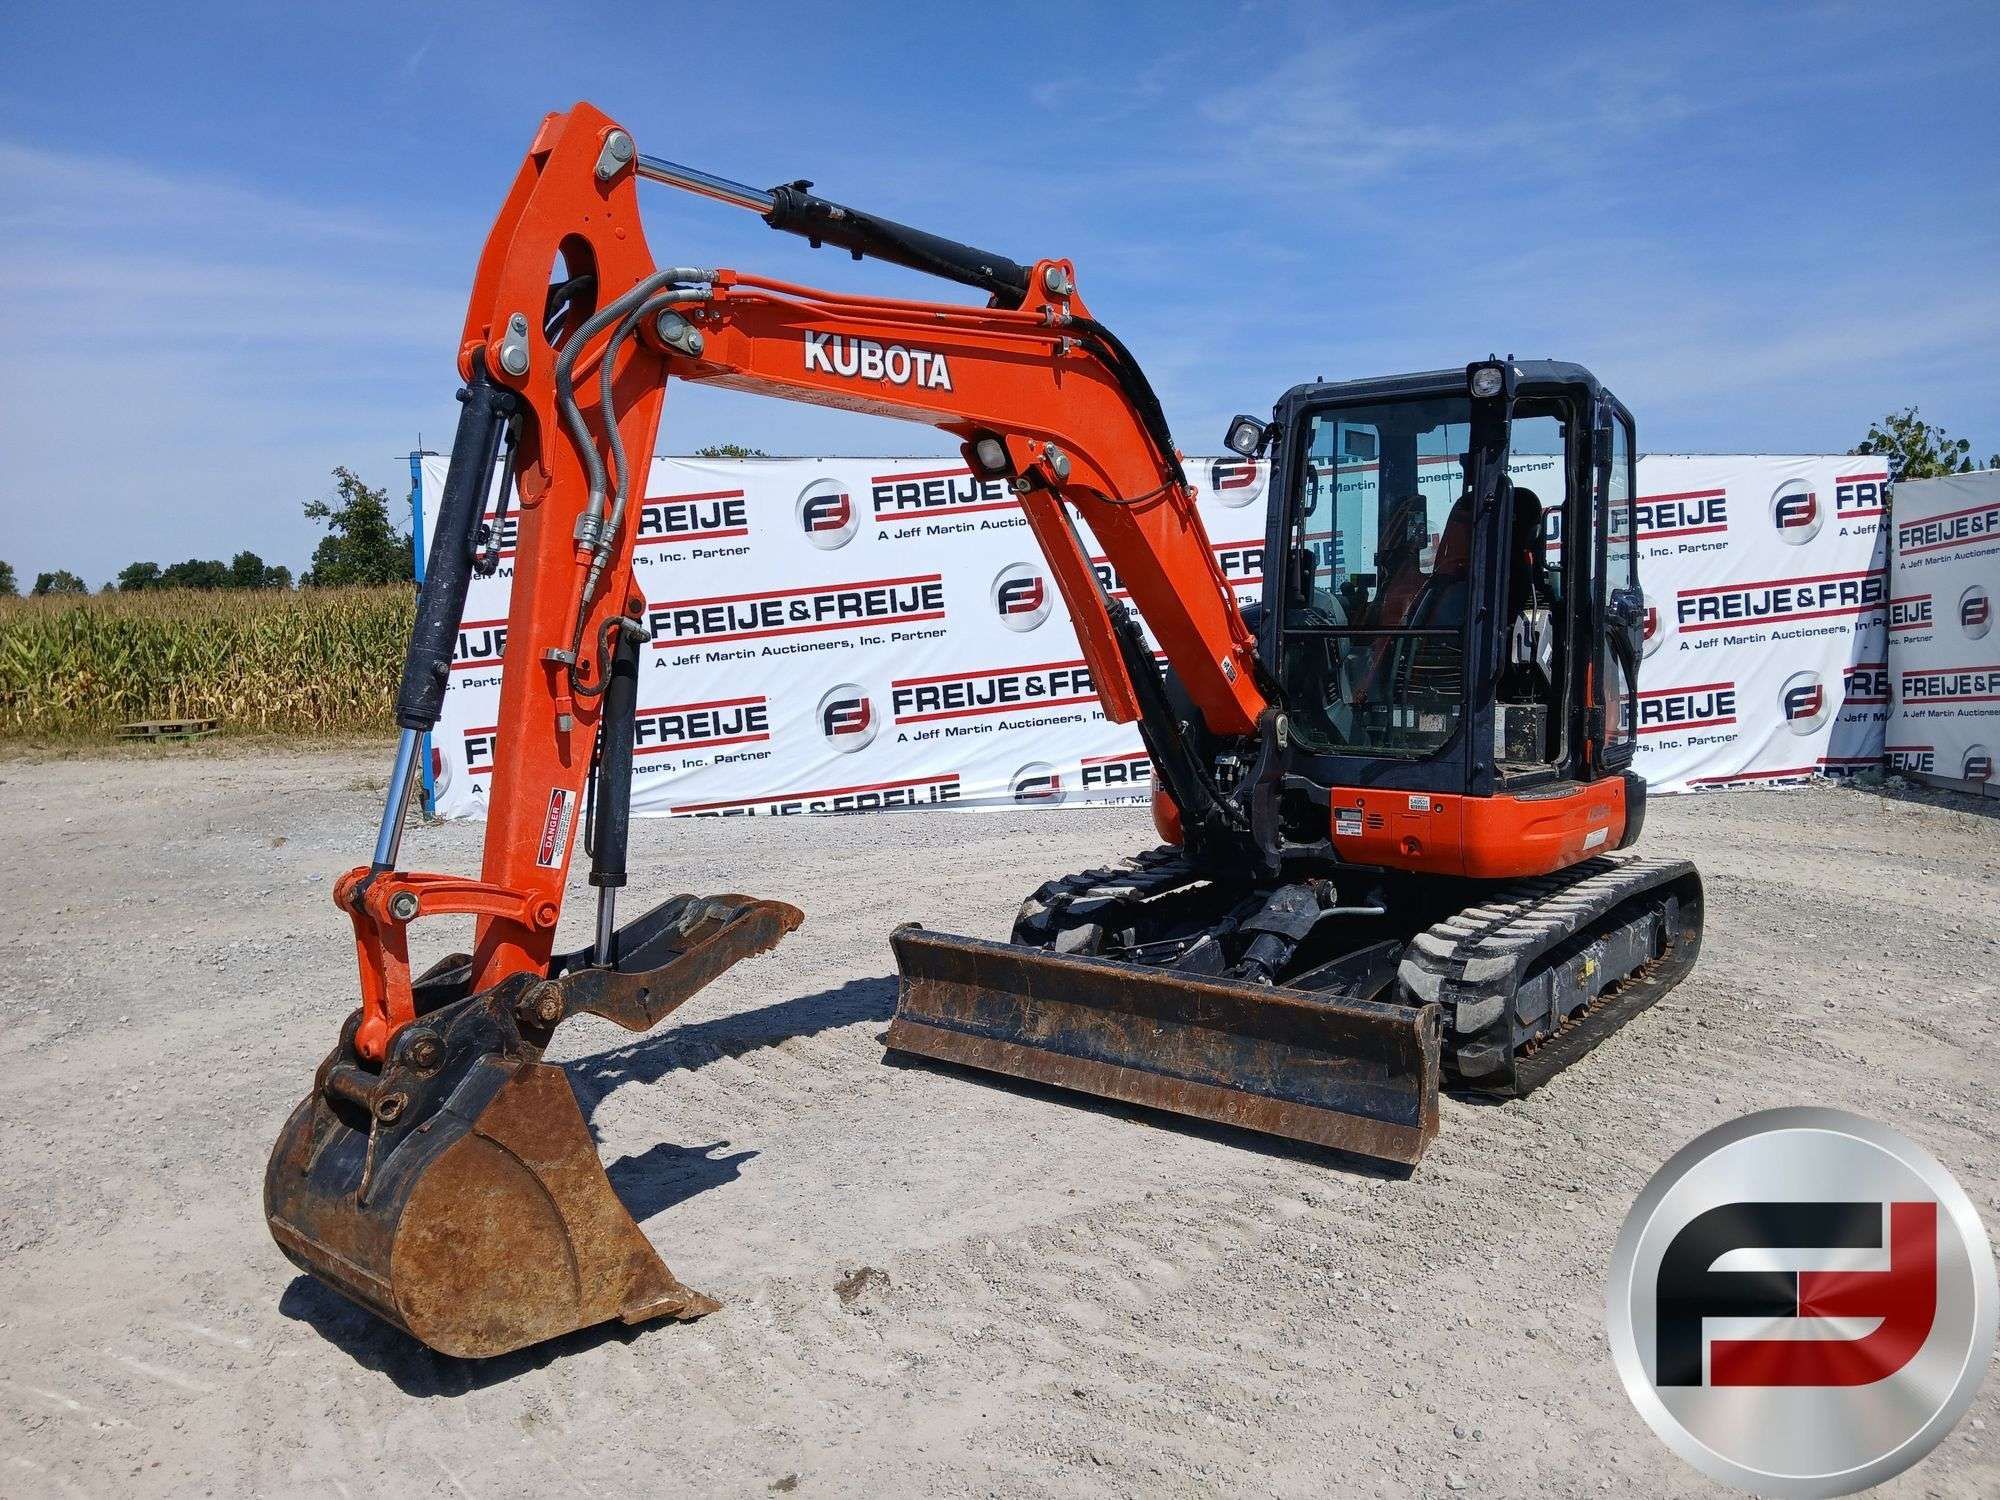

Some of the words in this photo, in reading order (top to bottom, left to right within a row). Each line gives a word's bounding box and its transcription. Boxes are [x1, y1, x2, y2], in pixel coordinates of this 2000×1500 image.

[804, 329, 952, 391] KUBOTA
[878, 530, 889, 541] A
[894, 527, 922, 539] Jeff
[927, 521, 975, 537] Martin
[1839, 527, 1848, 537] A
[1853, 524, 1877, 536] Jeff
[660, 553, 686, 563] Inc.
[692, 546, 750, 560] Partner
[1650, 547, 1674, 558] Inc.
[1678, 541, 1729, 554] Partner
[1908, 559, 1923, 569] Jeff
[1925, 554, 1951, 566] Martin
[1680, 642, 1690, 651] A
[1694, 639, 1719, 650] Jeff
[1723, 634, 1766, 646] Martin
[1771, 624, 1850, 641] Auctioneers,
[655, 658, 667, 669] A
[672, 654, 701, 667] Jeff
[706, 648, 756, 663] Martin
[761, 638, 854, 658] Auctioneers,
[860, 635, 886, 647] Inc.
[891, 629, 947, 643] Partner
[1911, 709, 1926, 719] Jeff
[1927, 709, 1955, 718] Martin
[897, 732, 908, 743] A
[913, 729, 941, 742] Jeff
[945, 723, 993, 738] Martin
[998, 713, 1087, 732] Auctioneers,
[1659, 740, 1682, 751] Inc.
[1688, 732, 1739, 747] Partner
[682, 759, 708, 769] Inc.
[714, 750, 772, 765] Partner
[545, 806, 560, 849] DANGER
